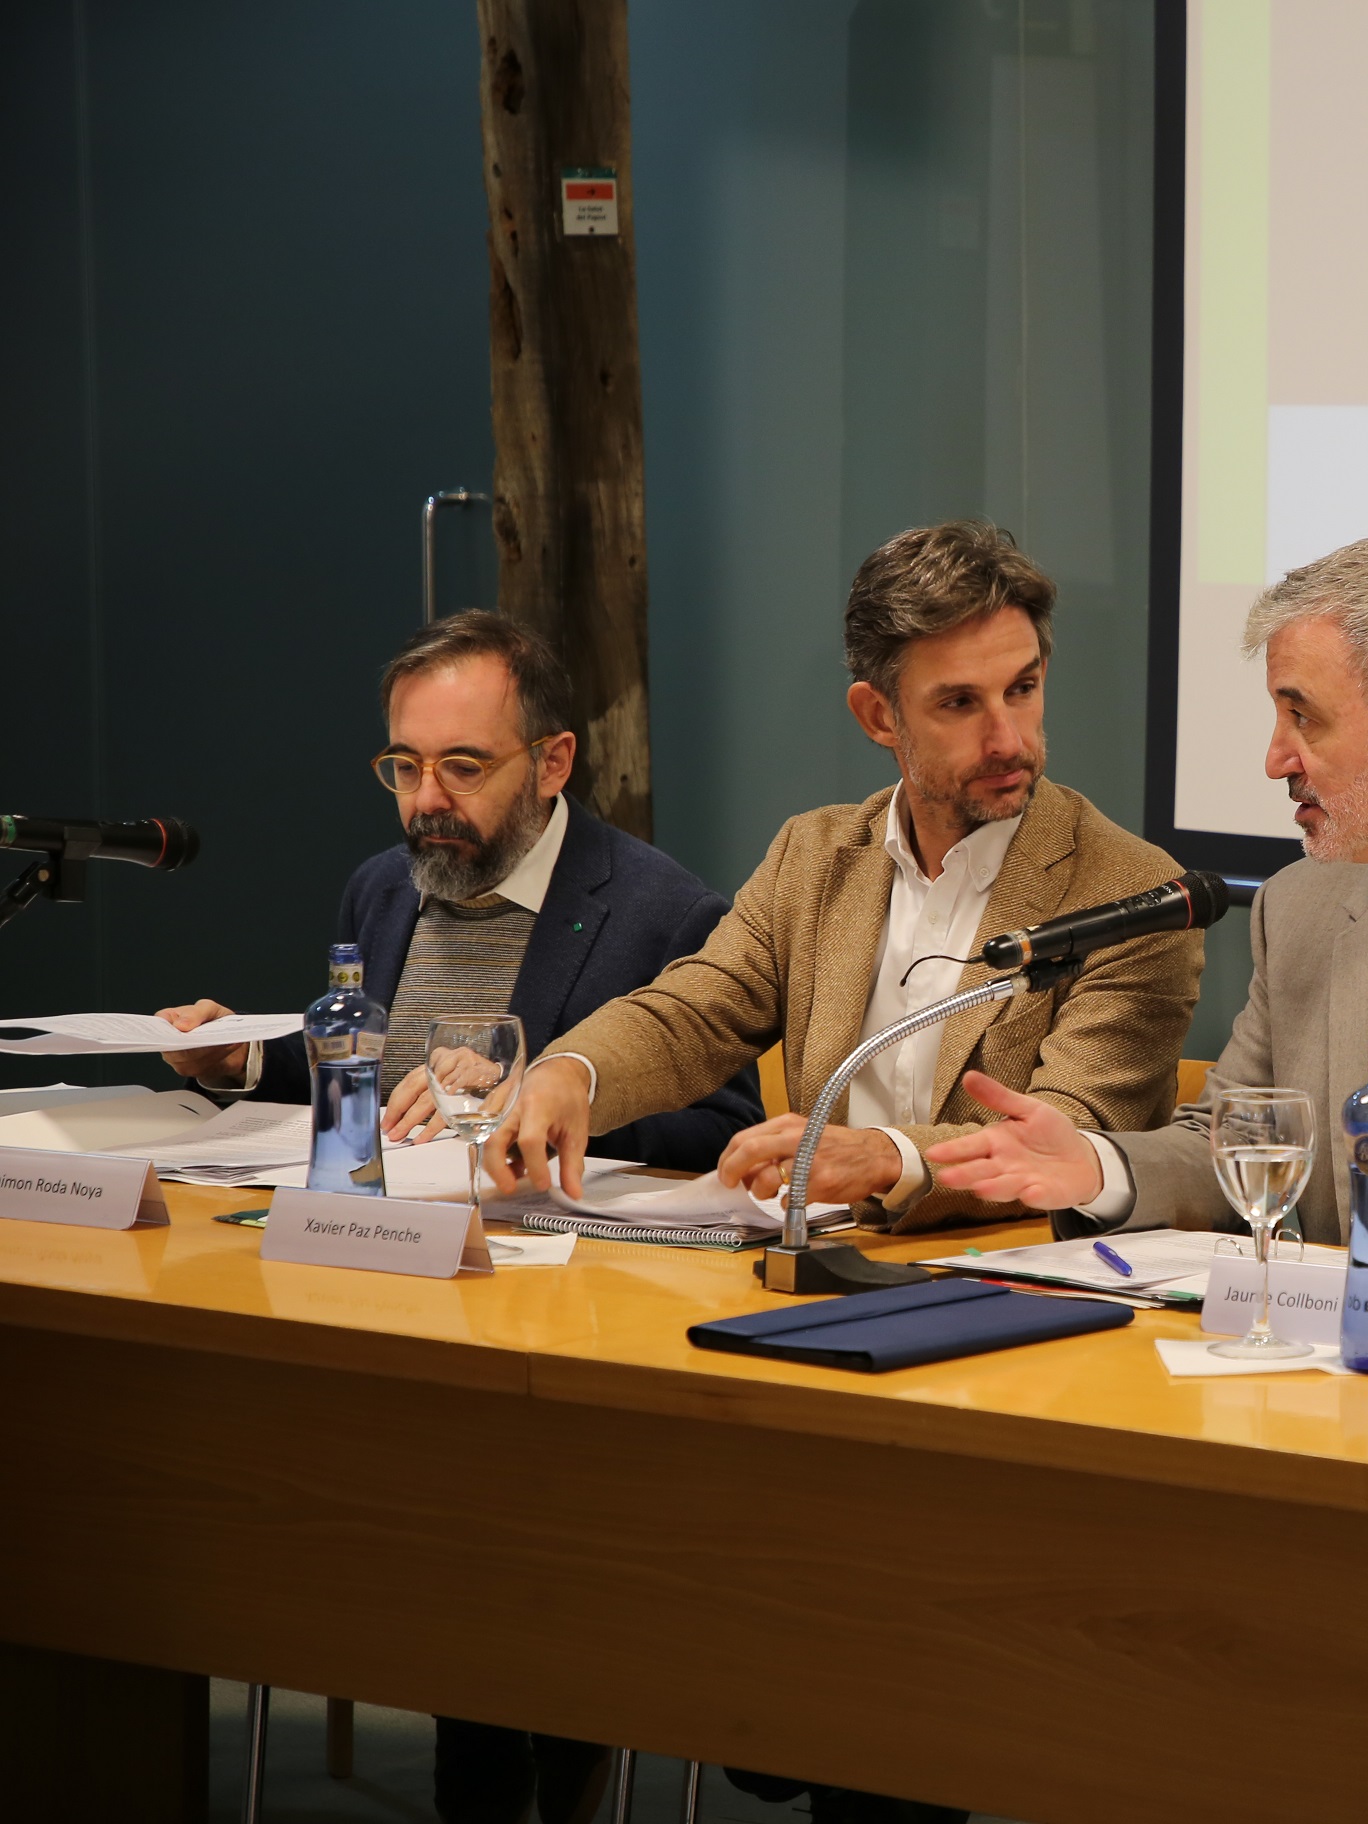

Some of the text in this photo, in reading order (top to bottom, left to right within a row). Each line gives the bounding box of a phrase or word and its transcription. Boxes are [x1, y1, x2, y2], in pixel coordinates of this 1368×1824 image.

[0, 1174, 103, 1200] imon Roda Noya
[304, 1218, 421, 1243] Xavier Paz Penche
[1276, 1291, 1339, 1312] Collboni
